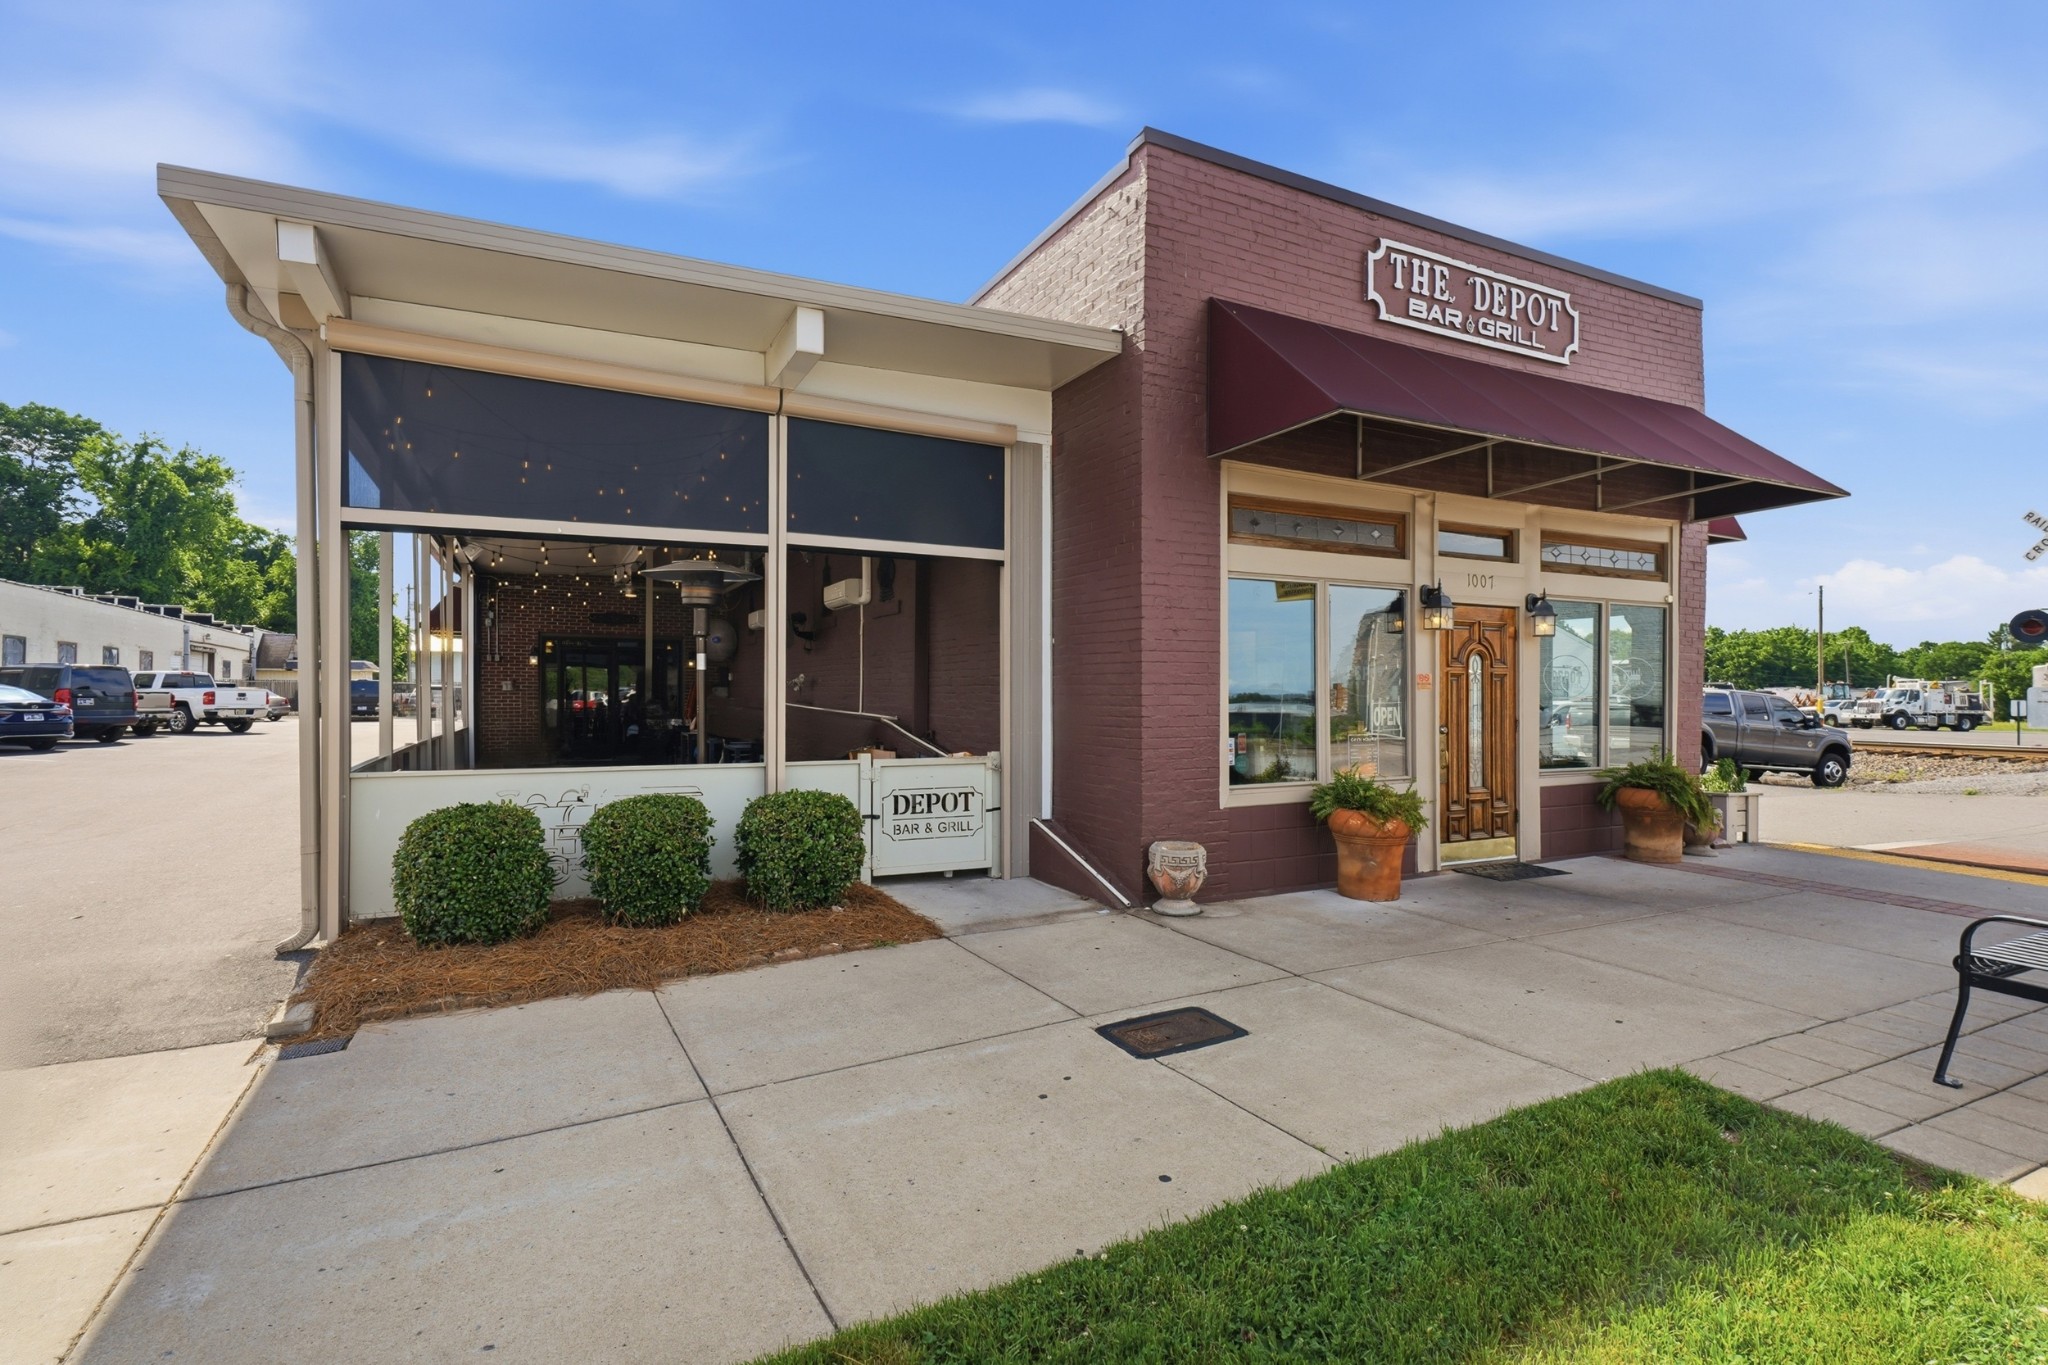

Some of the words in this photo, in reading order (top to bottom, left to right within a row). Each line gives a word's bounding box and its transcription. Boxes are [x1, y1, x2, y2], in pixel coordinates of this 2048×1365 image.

[1390, 253, 1455, 303] THE
[1468, 277, 1561, 332] DEPOT
[1409, 299, 1462, 329] BAR
[1478, 318, 1546, 349] GRILL
[1467, 573, 1494, 590] 1007
[1373, 706, 1401, 726] OPEN
[892, 792, 975, 815] DEPOT
[893, 822, 920, 836] BAR
[924, 822, 933, 834] &
[937, 820, 974, 833] GRILL
